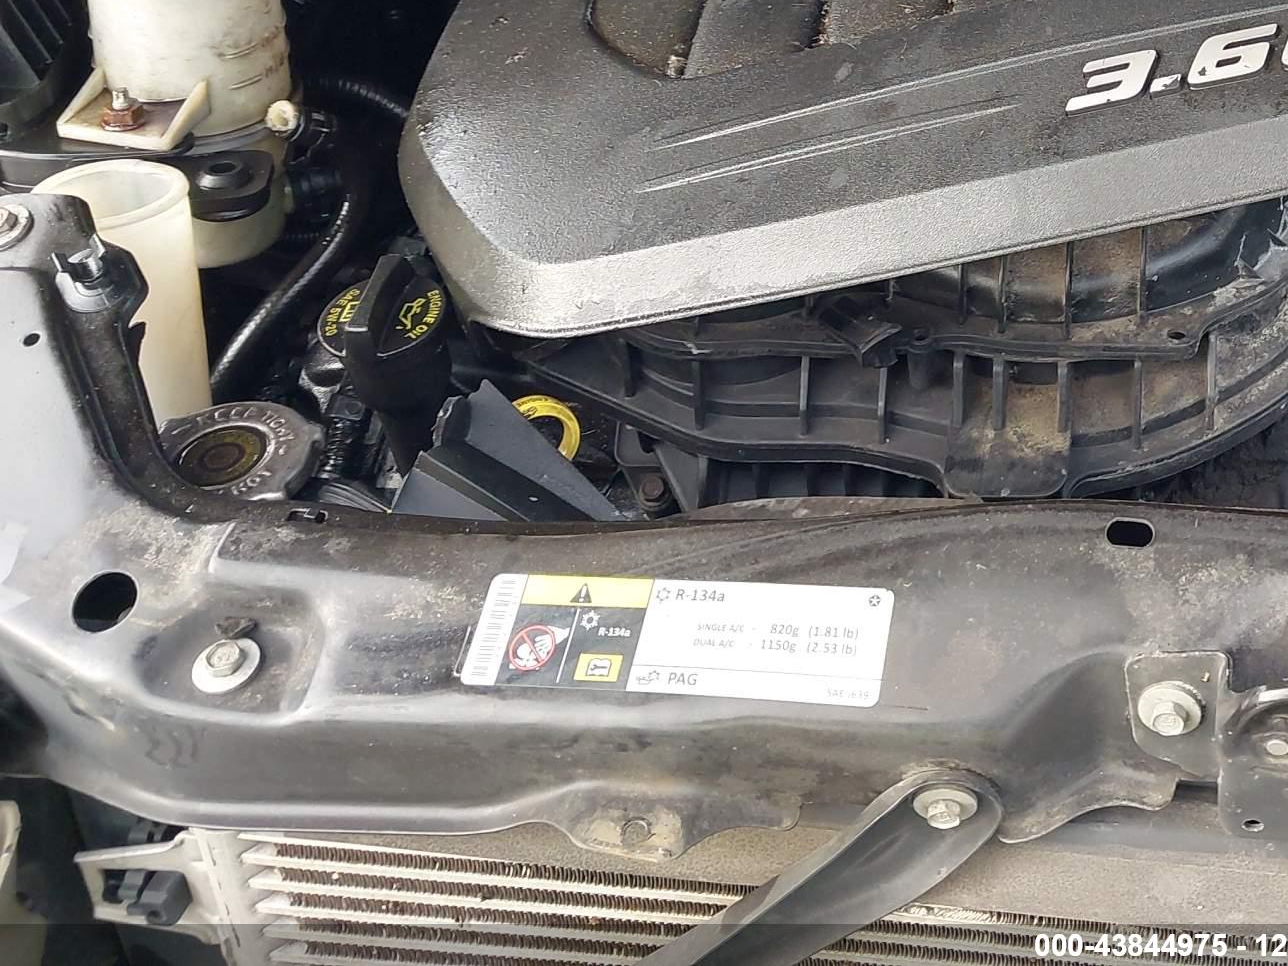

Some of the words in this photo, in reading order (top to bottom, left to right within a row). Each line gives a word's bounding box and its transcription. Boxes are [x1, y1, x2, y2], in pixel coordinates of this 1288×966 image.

[423, 289, 443, 324] ENGINE
[324, 307, 341, 337] 5W-20
[404, 324, 430, 340] OIL
[675, 588, 726, 603] R-134a
[598, 625, 632, 638] R-134a
[770, 624, 800, 638] 820g
[842, 627, 860, 640] lb)
[760, 639, 797, 653] 1150g
[841, 643, 858, 656] lb)
[667, 671, 699, 686] PAG
